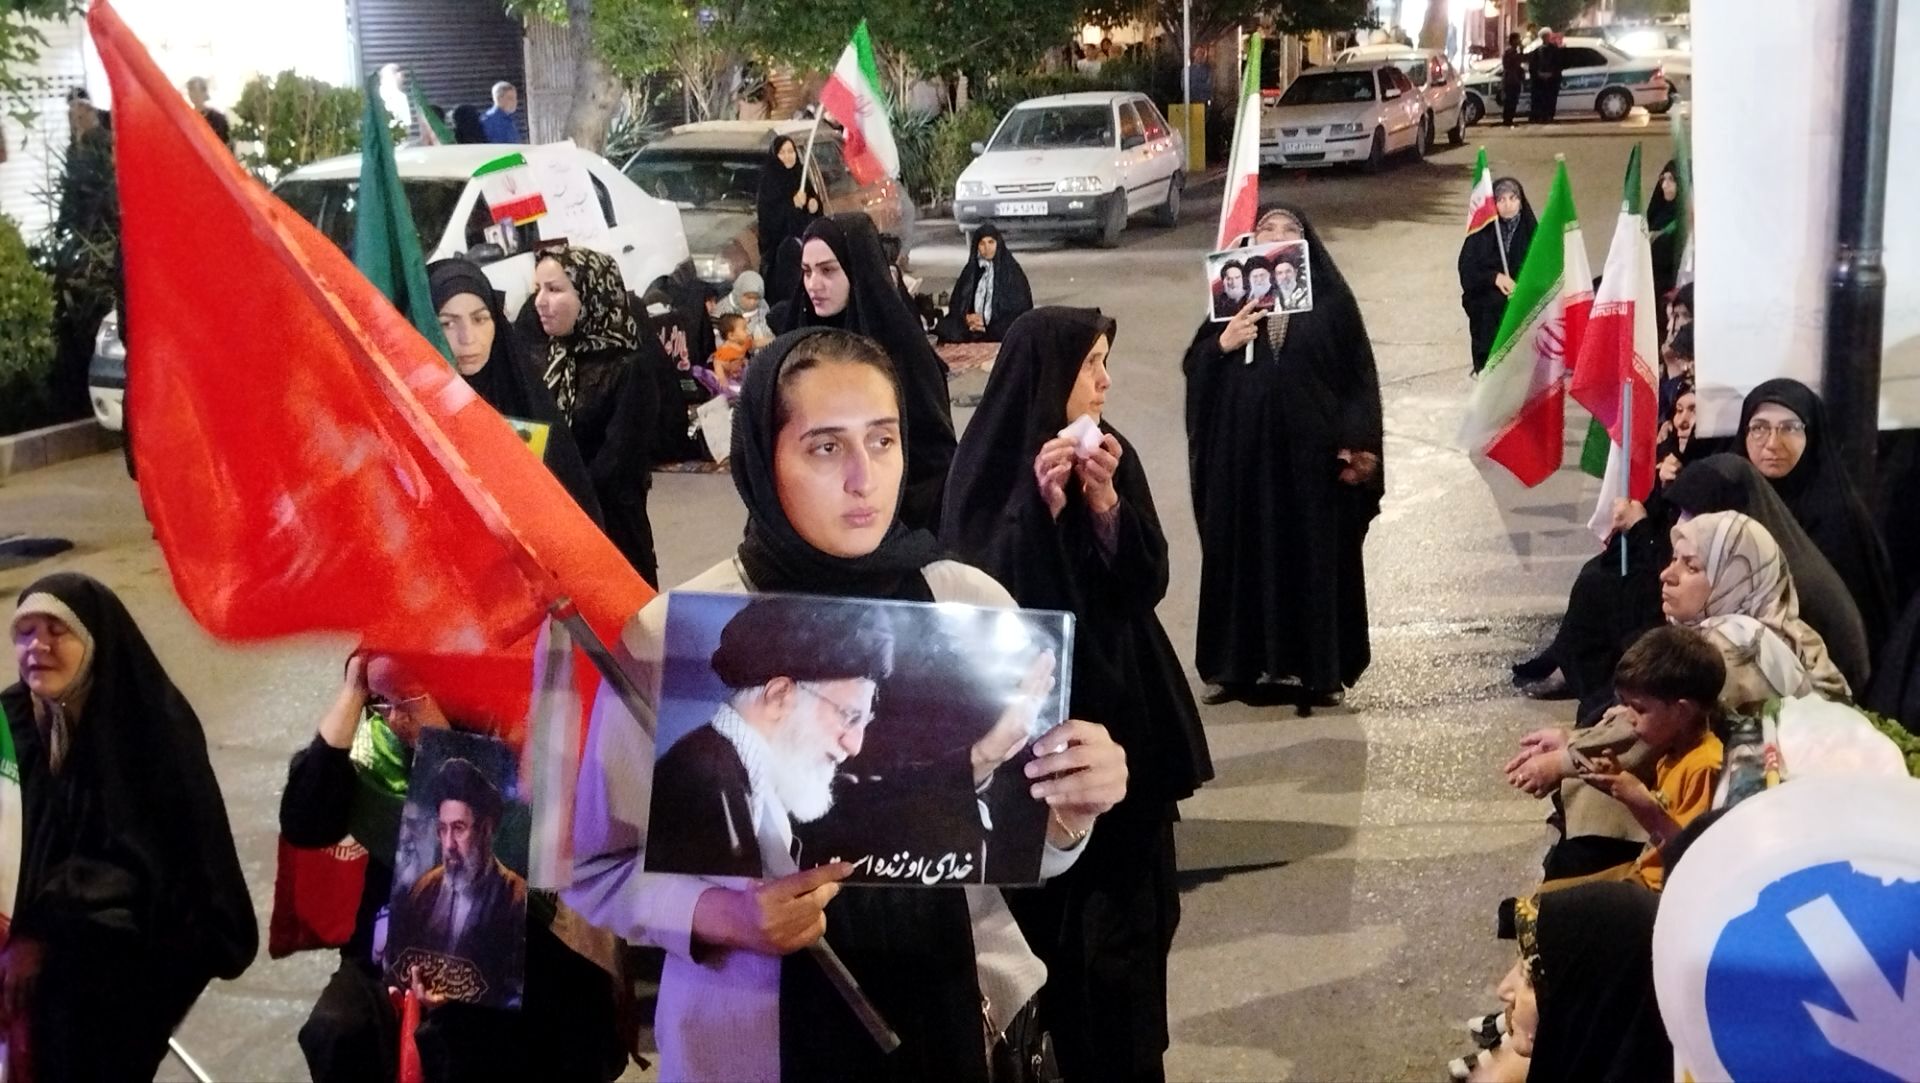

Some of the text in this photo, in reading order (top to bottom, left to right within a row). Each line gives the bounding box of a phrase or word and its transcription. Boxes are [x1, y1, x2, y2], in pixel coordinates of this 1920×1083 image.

[874, 850, 909, 878] زنده
[904, 856, 924, 878] او
[922, 852, 974, 885] خدای
